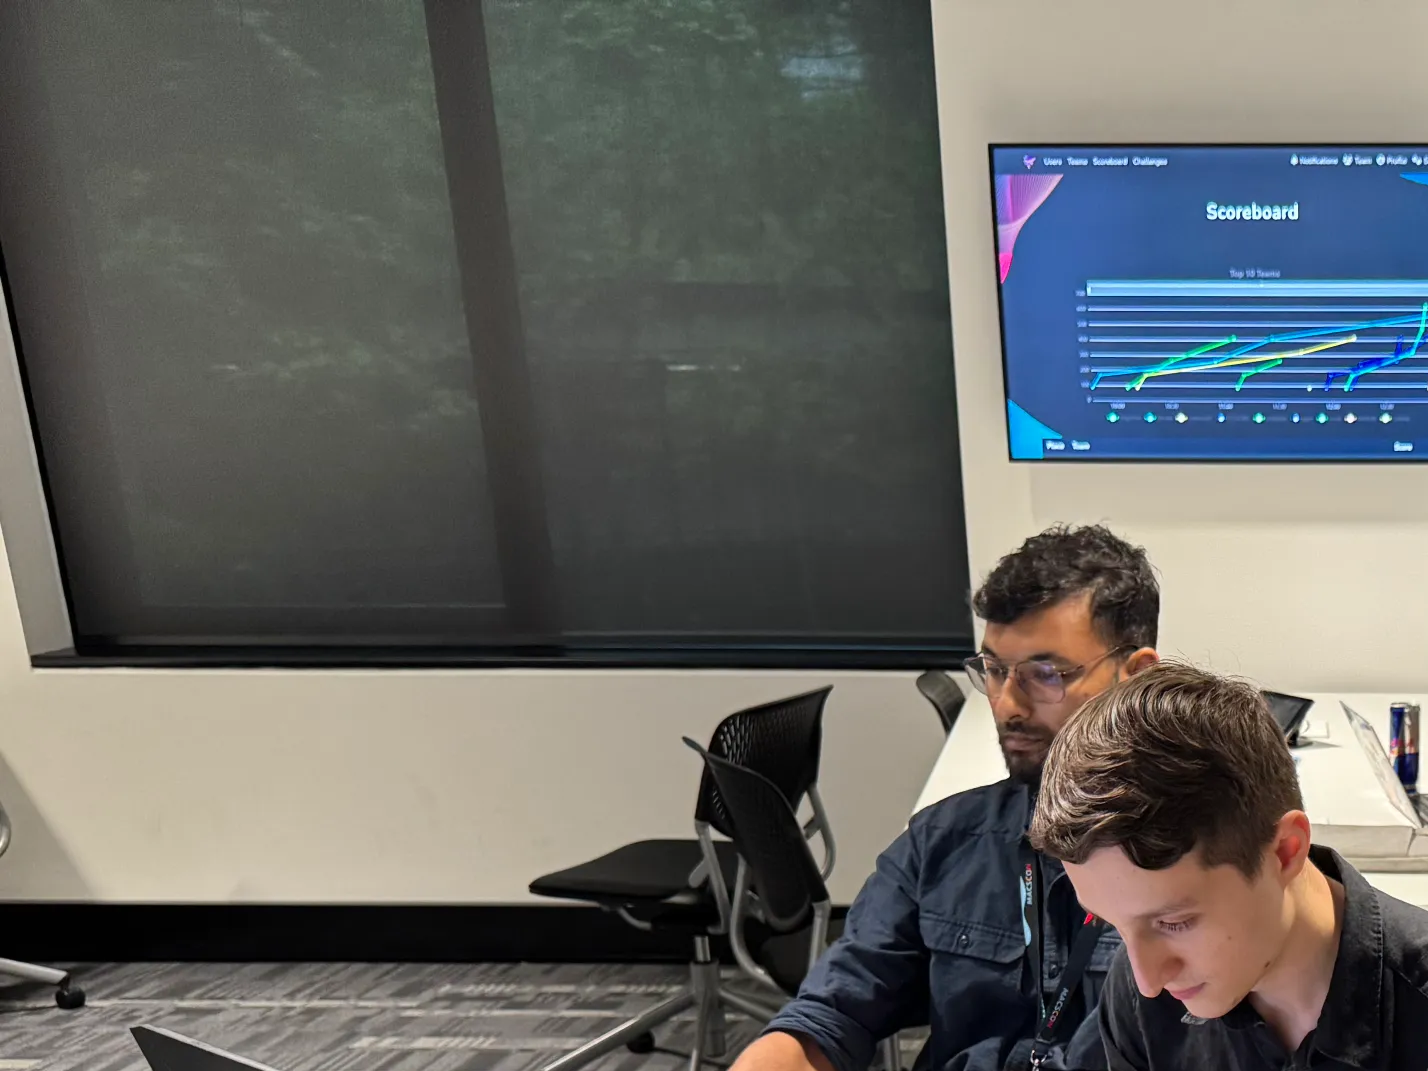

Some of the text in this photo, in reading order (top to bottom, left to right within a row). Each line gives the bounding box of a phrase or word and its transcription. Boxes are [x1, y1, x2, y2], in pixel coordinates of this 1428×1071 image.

[1042, 157, 1168, 168] Users Teams Scoreboard Challenges
[1299, 154, 1339, 165] Notifications
[1386, 154, 1408, 165] Profile
[1206, 202, 1299, 221] Scoreboard
[1025, 863, 1033, 906] MACSCON
